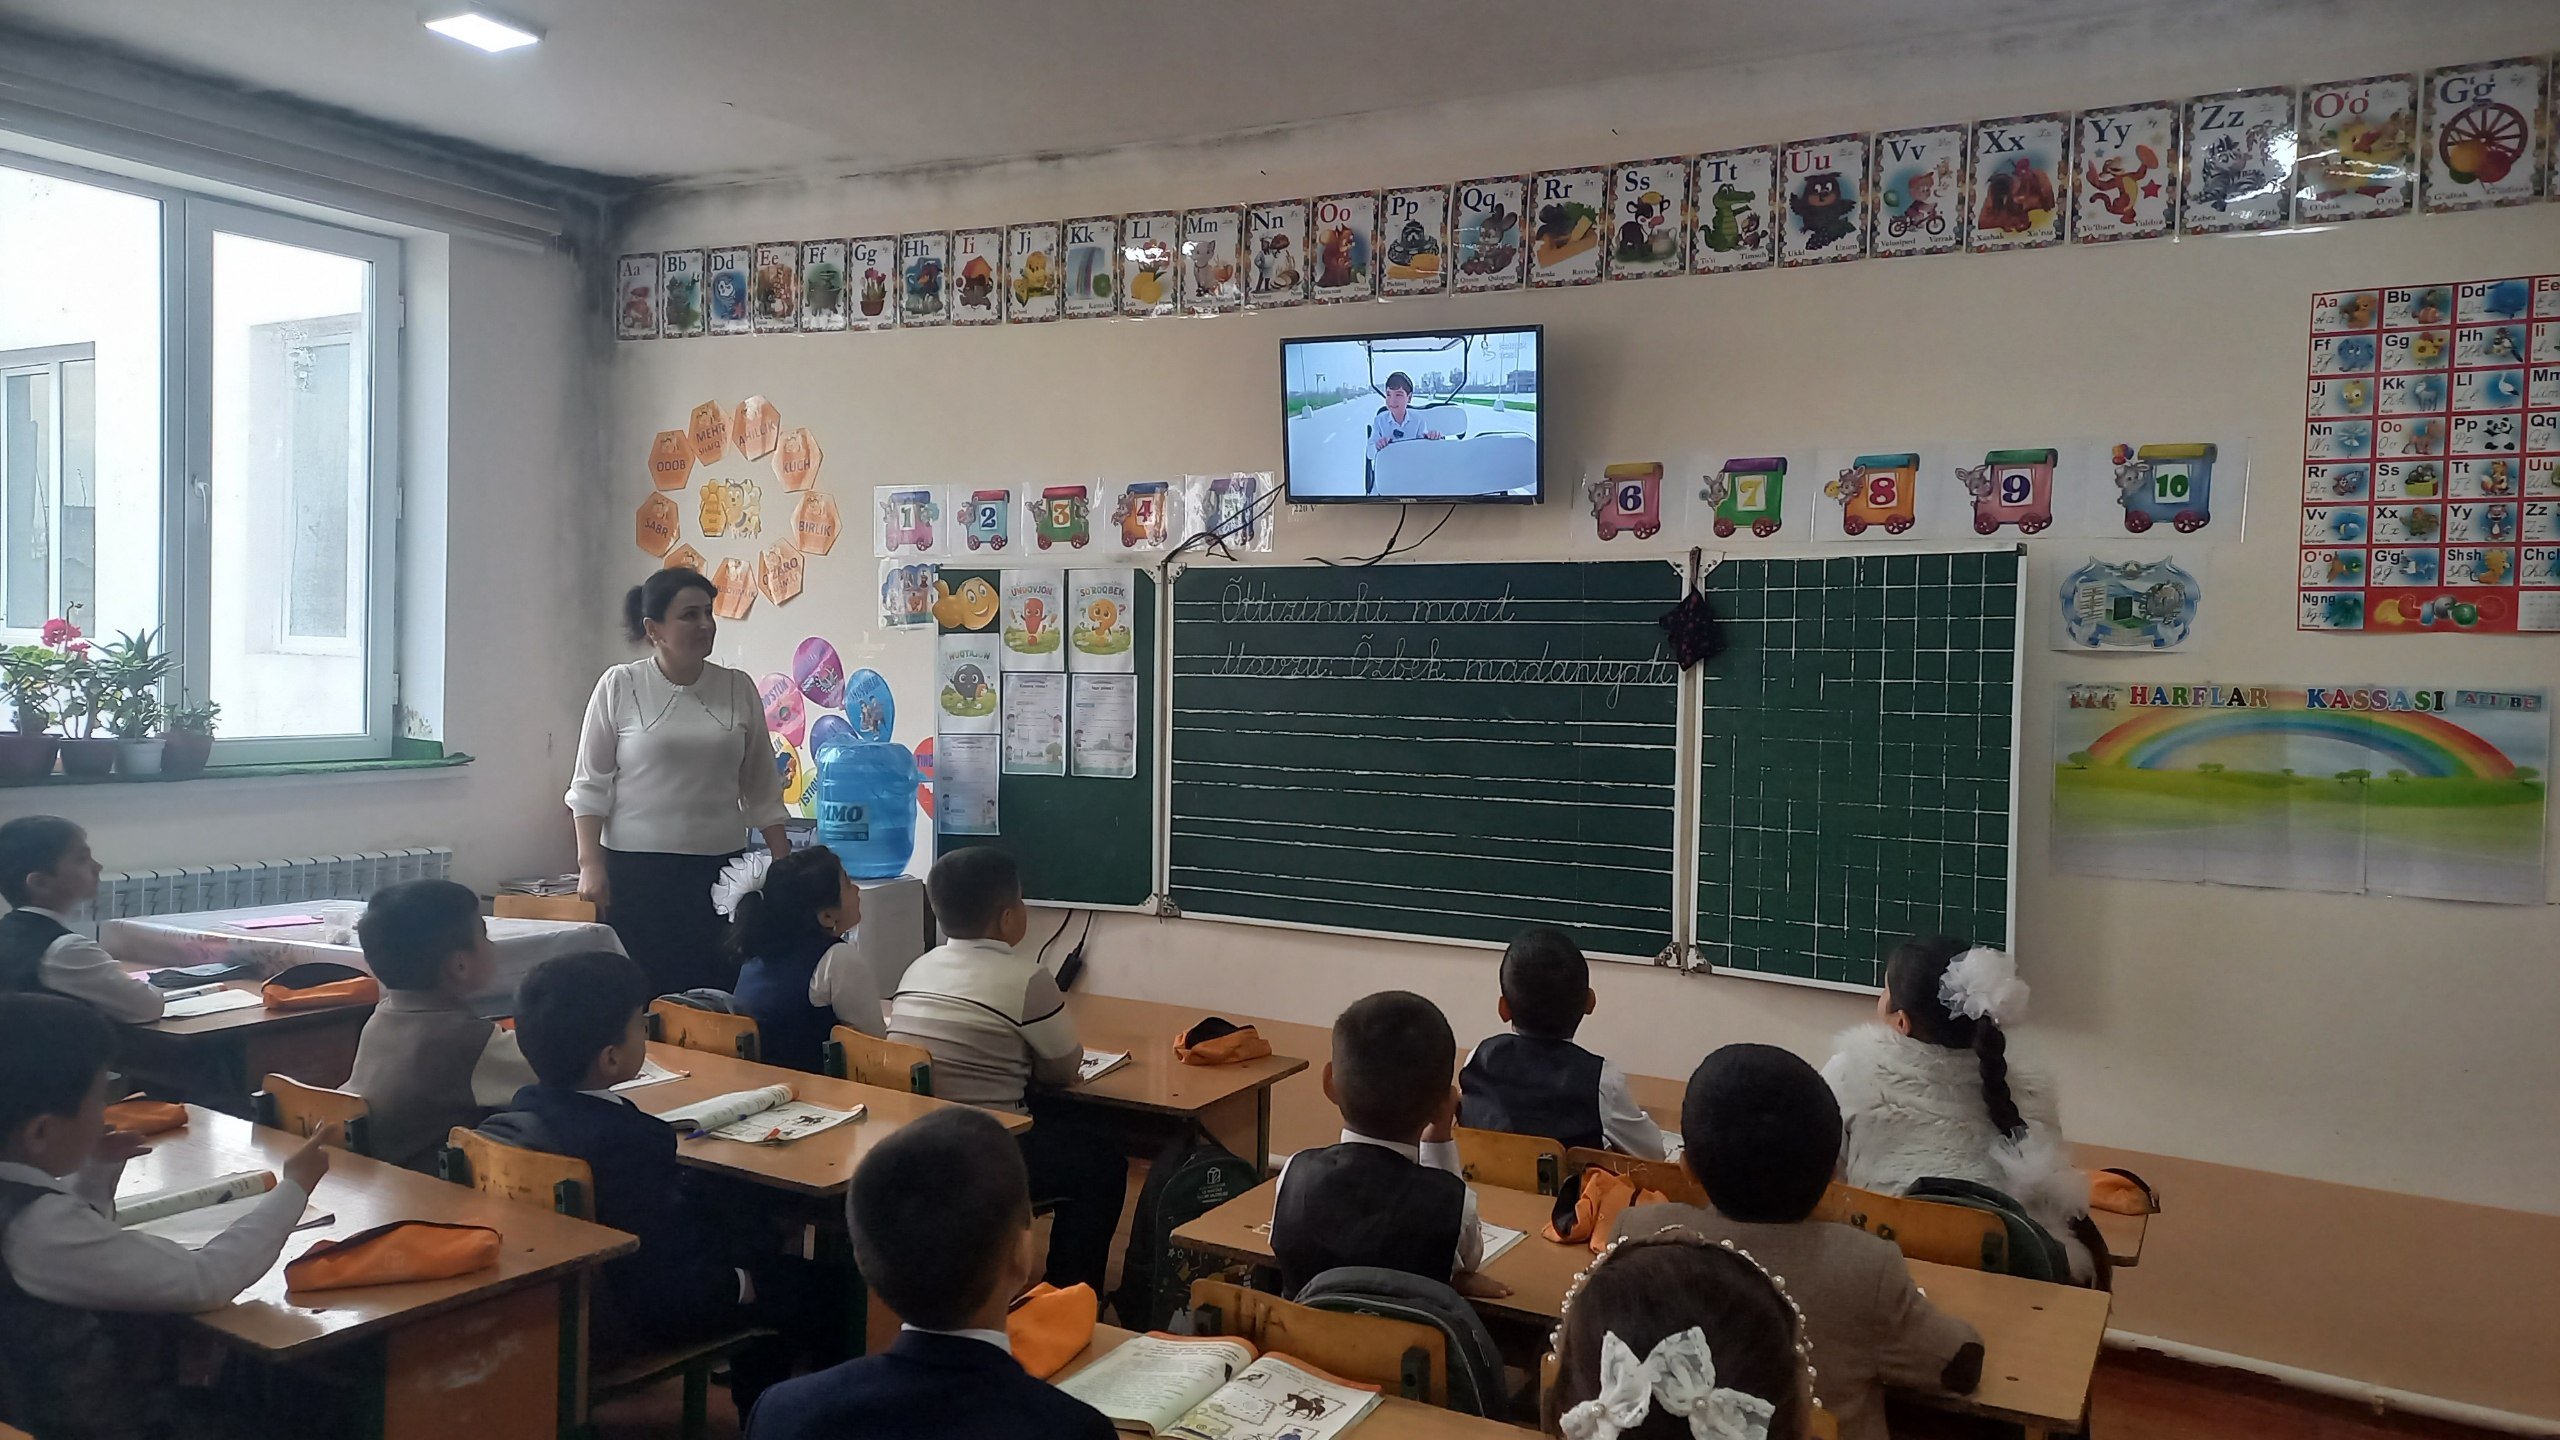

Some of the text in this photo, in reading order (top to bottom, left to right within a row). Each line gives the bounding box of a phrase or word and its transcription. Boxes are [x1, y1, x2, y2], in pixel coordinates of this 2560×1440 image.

[2199, 104, 2245, 131] Zz
[1982, 130, 2025, 154] Xx
[2089, 118, 2133, 149] Yy
[1888, 139, 1926, 162] Vv
[1789, 150, 1831, 174] Uu
[1707, 159, 1738, 184] Tt
[1544, 179, 1573, 200] Rr
[1624, 170, 1650, 192] Ss
[1391, 197, 1418, 222] Pp
[1463, 188, 1495, 214] Qq
[1252, 212, 1284, 231] Nn
[1320, 204, 1351, 223] Oo
[1132, 220, 1150, 239] Ll
[1187, 218, 1218, 235] Mm
[1017, 231, 1031, 255] Jj
[1069, 227, 1095, 244] Kk
[903, 241, 930, 257] Hh
[962, 237, 975, 254] Ii
[712, 255, 735, 271] Dd
[759, 252, 779, 267] Ee
[808, 247, 826, 264] Ff
[854, 245, 878, 265] Gg
[622, 262, 641, 278] Aa
[667, 258, 687, 273] Bb
[2387, 291, 2411, 303] Bb
[2461, 284, 2486, 298] Dd
[2315, 297, 2338, 309] Aa
[2459, 330, 2483, 342] Hh
[2536, 324, 2545, 337] Ii
[2314, 339, 2331, 351] Ff
[2385, 335, 2410, 349] Gg
[2312, 381, 2326, 396] Jj
[2383, 378, 2405, 390] Kk
[2456, 374, 2472, 386] Ll
[2310, 424, 2332, 436] Nn
[2381, 421, 2402, 433] Oo
[2454, 418, 2478, 432] Pp
[2530, 414, 2557, 429] Qq
[656, 460, 686, 472] ODOB
[783, 458, 811, 474] KUCH
[2308, 466, 2328, 478] Rr
[2379, 464, 2399, 476] Ss
[2452, 461, 2470, 474] Tt
[2529, 459, 2553, 471] Uu
[1870, 477, 1896, 508] 8
[2003, 474, 2030, 504] 9
[2156, 474, 2189, 499] 10
[1619, 486, 1642, 512] 6
[1739, 482, 1760, 510] 7
[981, 507, 996, 529] 2
[1053, 504, 1070, 527] 3
[1137, 501, 1152, 523] 4
[2306, 509, 2327, 520] Vv
[2376, 507, 2398, 519] Xx
[2450, 505, 2472, 520] Yy
[2525, 504, 2547, 516] Zz
[901, 508, 914, 530] 1
[644, 519, 668, 539] SABR
[798, 521, 832, 537] BIRLIK
[1010, 586, 1054, 597] UNDOVJON
[1412, 582, 1516, 623] mart
[1463, 641, 1673, 709] madaniyati
[2127, 685, 2447, 713] HARFLAR KASSASI
